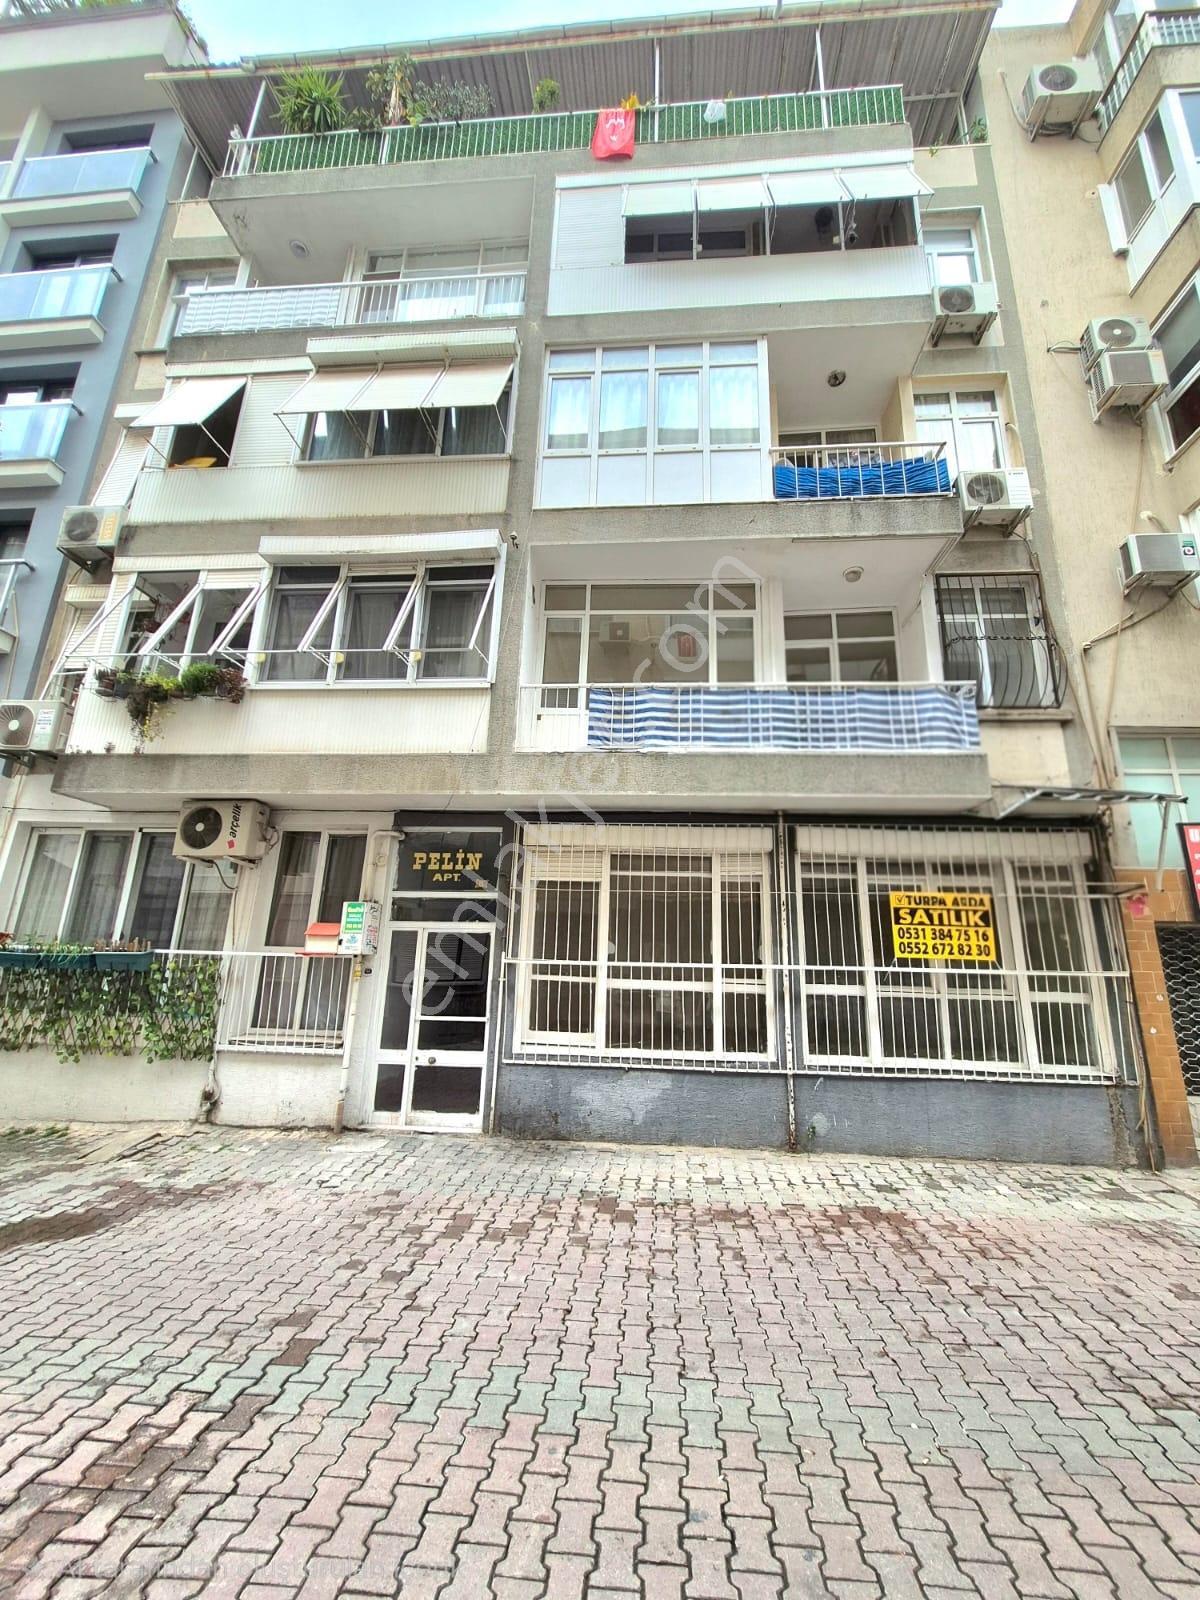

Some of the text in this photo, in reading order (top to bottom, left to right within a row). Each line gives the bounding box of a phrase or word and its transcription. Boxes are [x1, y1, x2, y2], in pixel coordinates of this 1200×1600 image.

[229, 802, 242, 838] arçelik
[412, 848, 483, 871] PELİN
[898, 908, 986, 926] SATILIK
[897, 927, 990, 942] 0531 384 75 16
[898, 942, 991, 957] 0552 672 82 30
